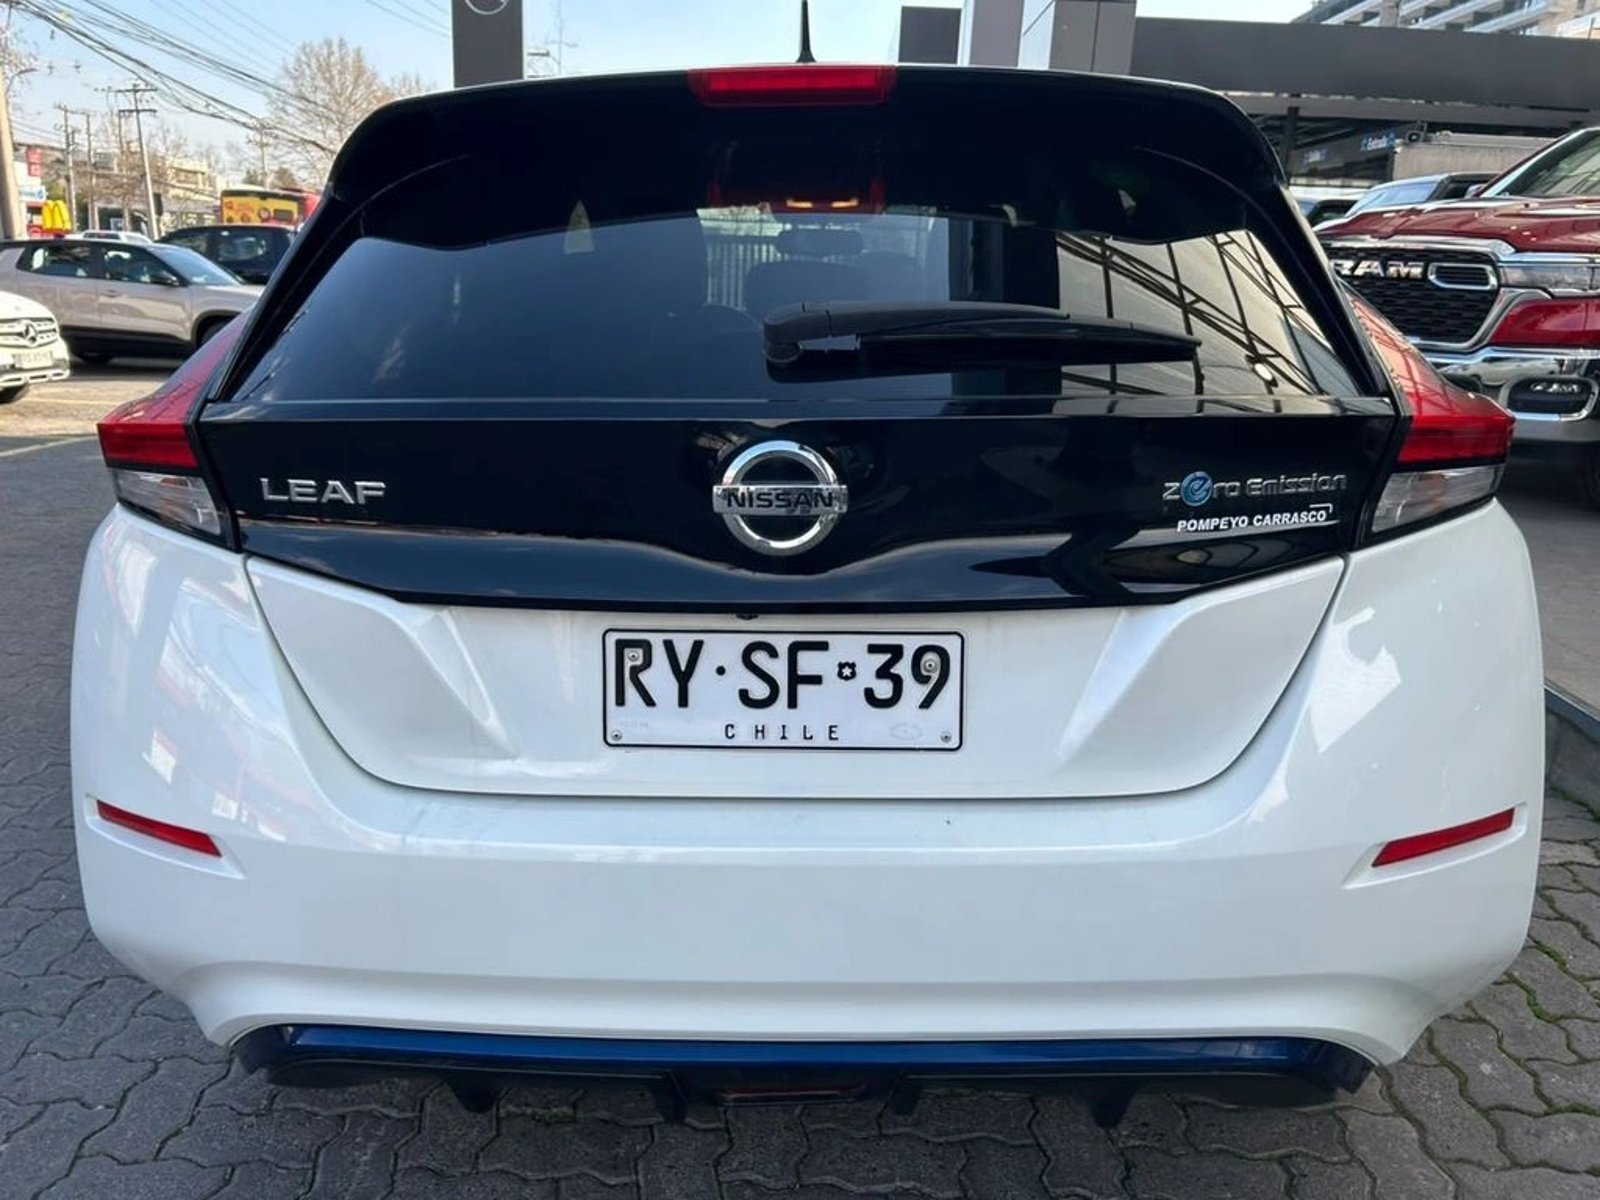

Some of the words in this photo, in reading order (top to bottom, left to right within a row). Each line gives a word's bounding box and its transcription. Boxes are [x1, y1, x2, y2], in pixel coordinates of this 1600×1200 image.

[1329, 259, 1424, 279] RAM
[260, 477, 386, 504] LEAF
[1246, 473, 1347, 497] Emission
[727, 489, 833, 508] NISSAN
[1177, 515, 1248, 532] POMPEYO
[1252, 510, 1326, 526] CARRASCO
[724, 723, 839, 742] CHILE
